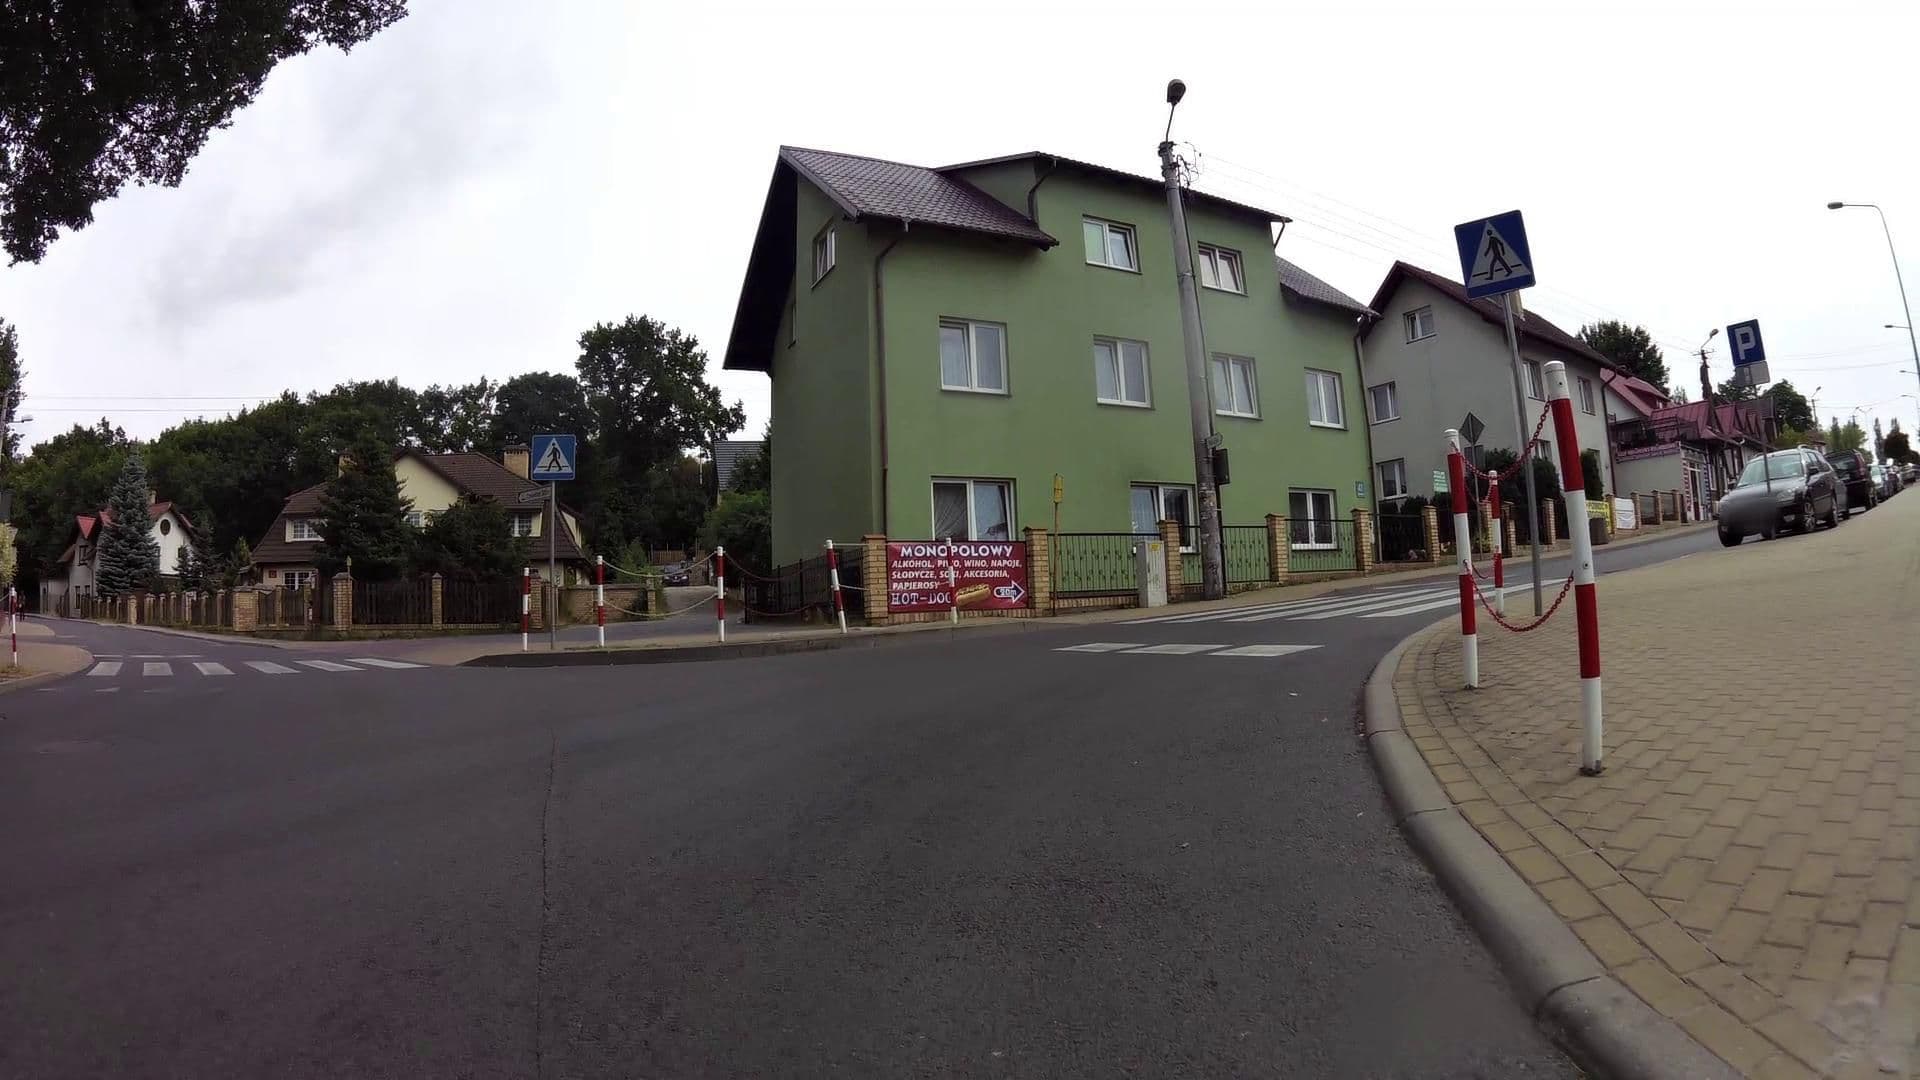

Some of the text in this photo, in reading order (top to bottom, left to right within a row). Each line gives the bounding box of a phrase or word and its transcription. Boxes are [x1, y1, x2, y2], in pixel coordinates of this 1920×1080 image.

[1734, 326, 1756, 360] P
[901, 545, 1012, 557] MONOPOLOWY
[892, 560, 934, 569] ALKOHOL,
[964, 560, 989, 568] WINO,
[892, 570, 937, 580] SŁODYCZE,
[963, 569, 1009, 578] AKCESORIA,
[893, 581, 939, 590] PAPIEROSY
